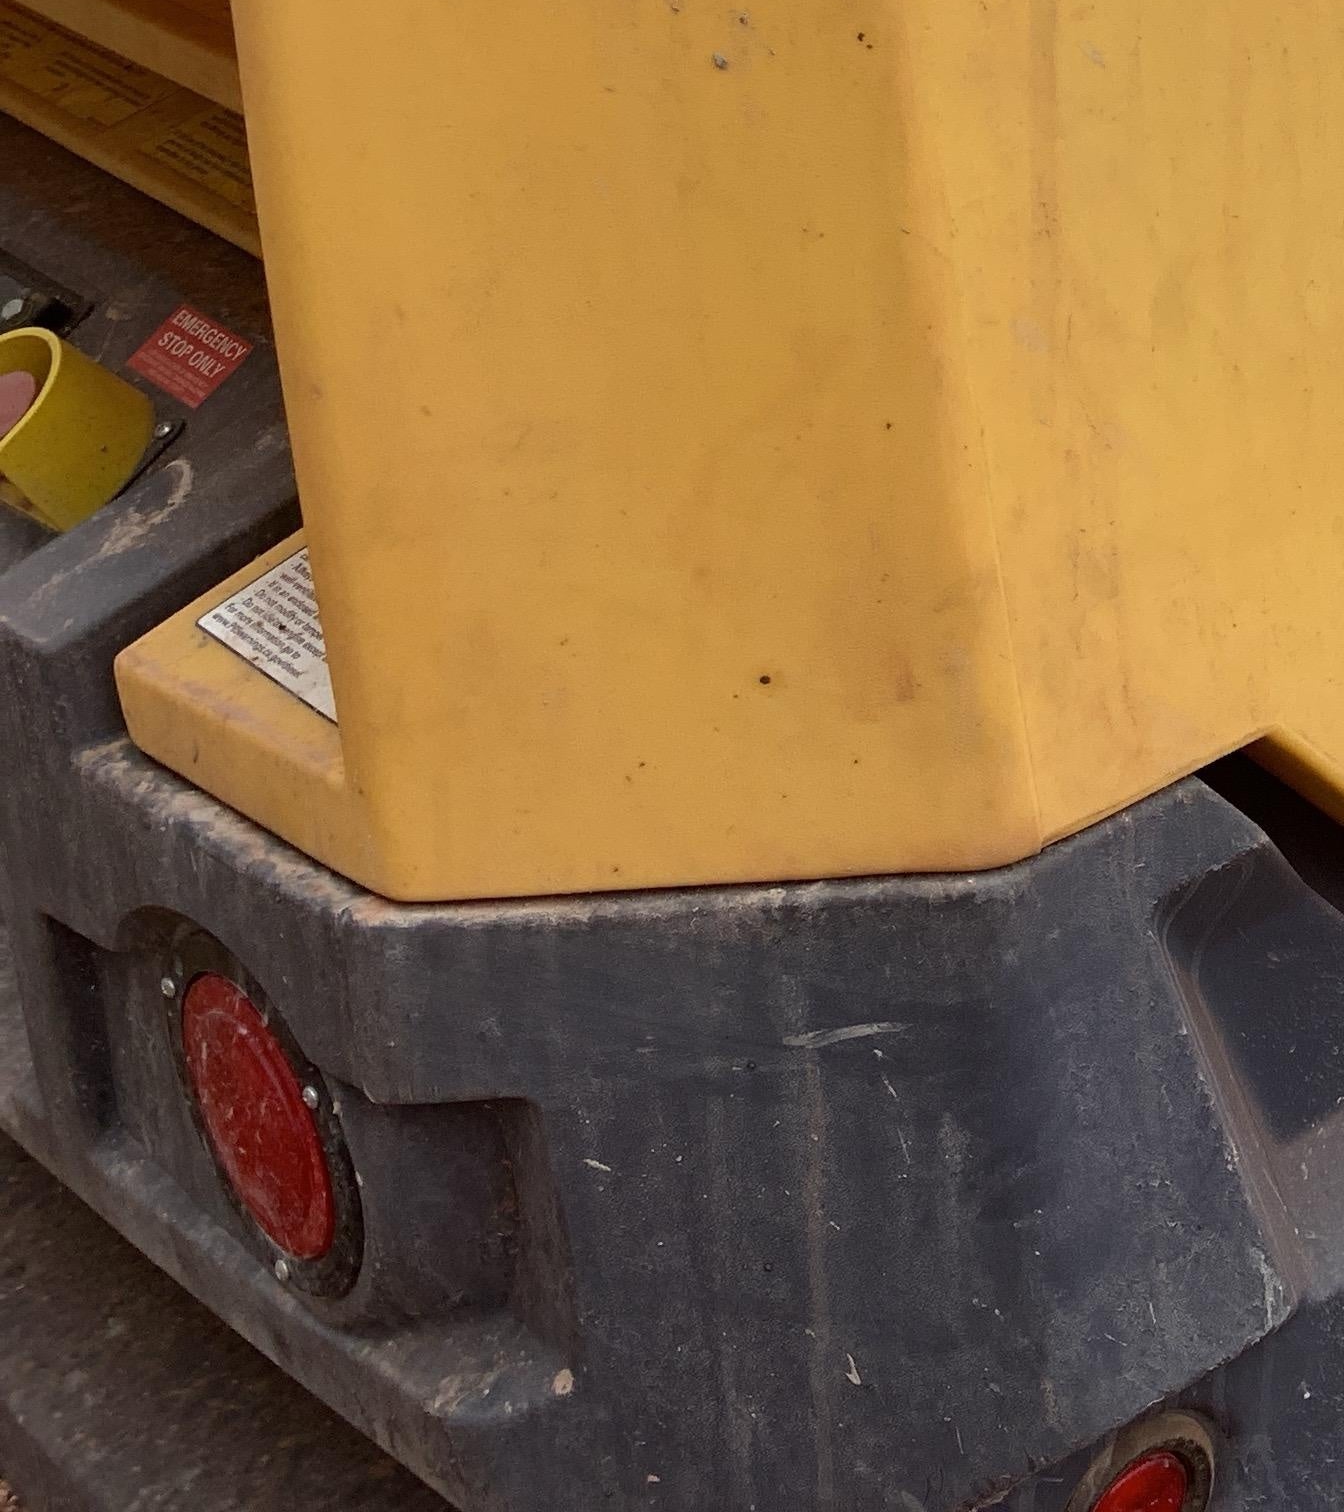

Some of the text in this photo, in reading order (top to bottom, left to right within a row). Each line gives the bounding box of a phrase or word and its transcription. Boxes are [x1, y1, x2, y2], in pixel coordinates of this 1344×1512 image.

[157, 330, 195, 358] STOP
[187, 349, 227, 379] ONLY
[172, 308, 248, 362] EMERGENCY
